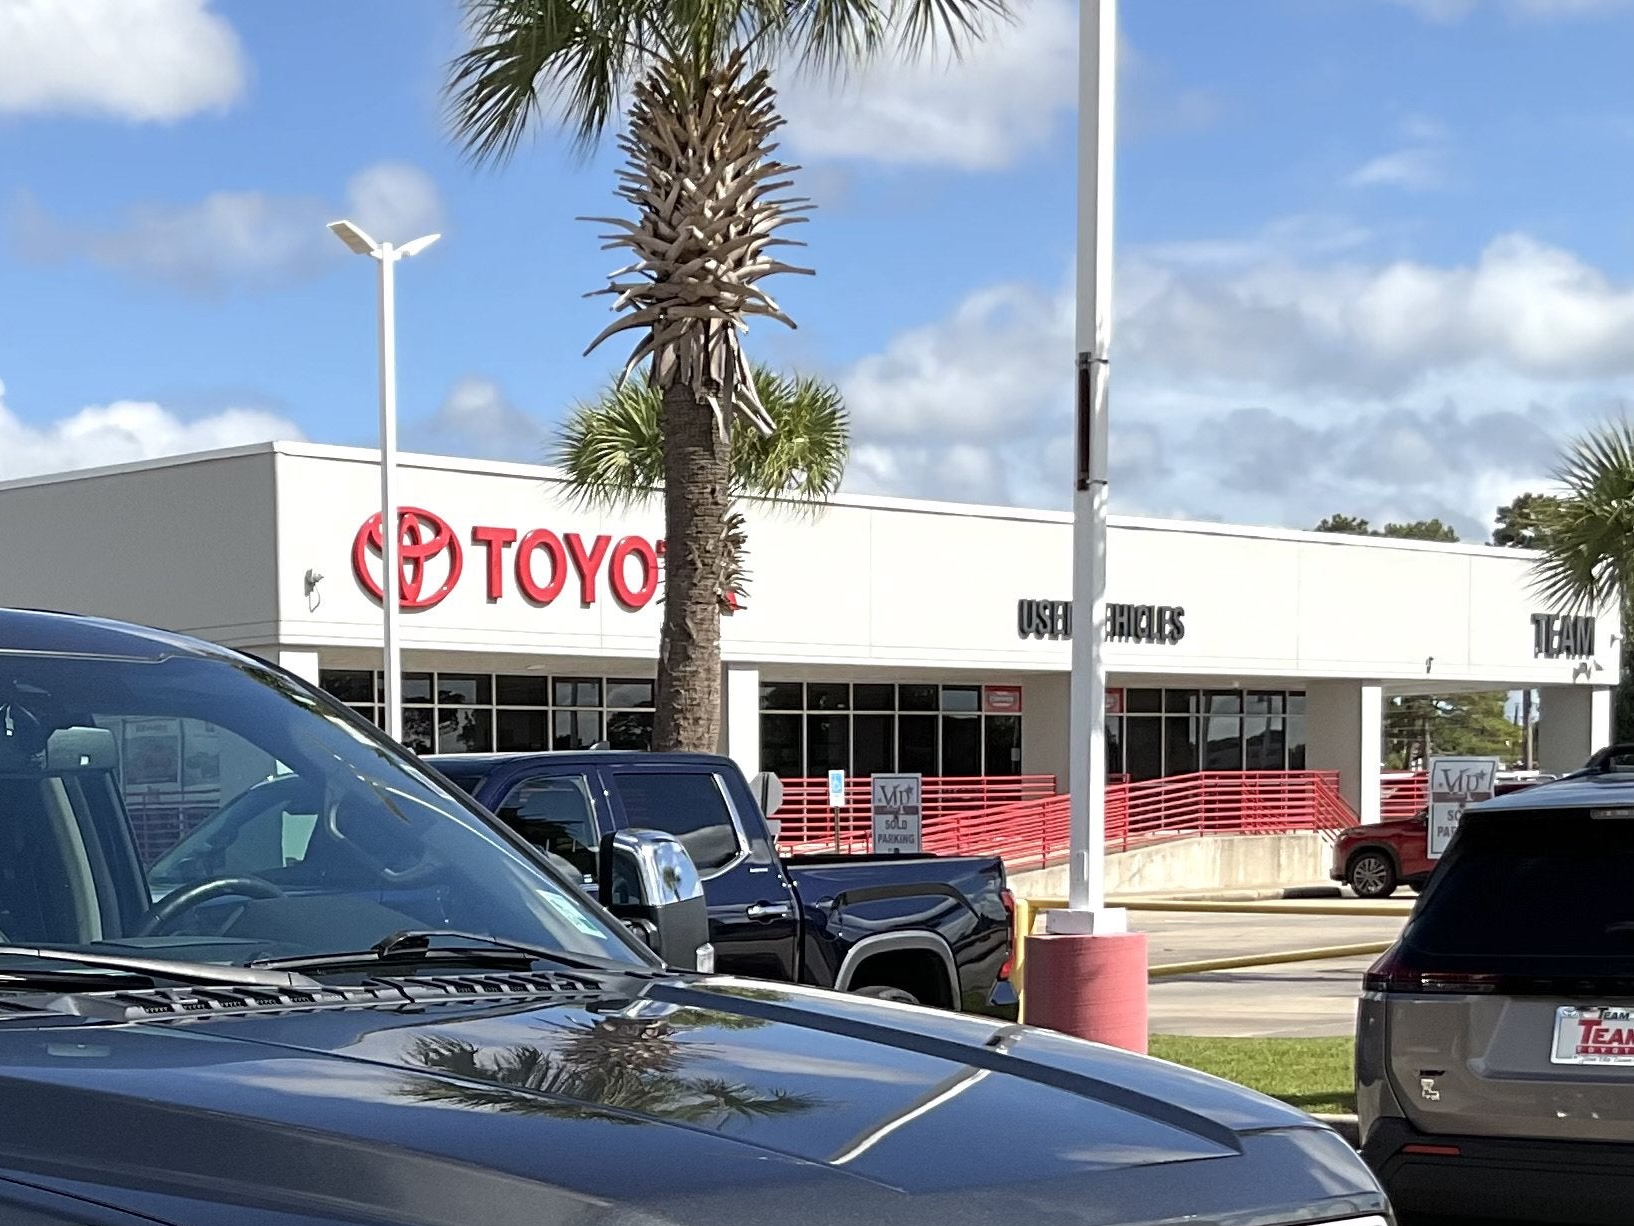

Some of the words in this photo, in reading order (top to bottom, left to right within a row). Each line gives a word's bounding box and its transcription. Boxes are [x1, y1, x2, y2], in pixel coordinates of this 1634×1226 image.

[471, 526, 737, 616] TOYO
[1530, 613, 1595, 660] TEAM
[885, 819, 908, 830] SOLD
[877, 833, 915, 844] PARKING
[1597, 1007, 1631, 1021] TEAM
[1576, 1046, 1631, 1054] TOYOT
